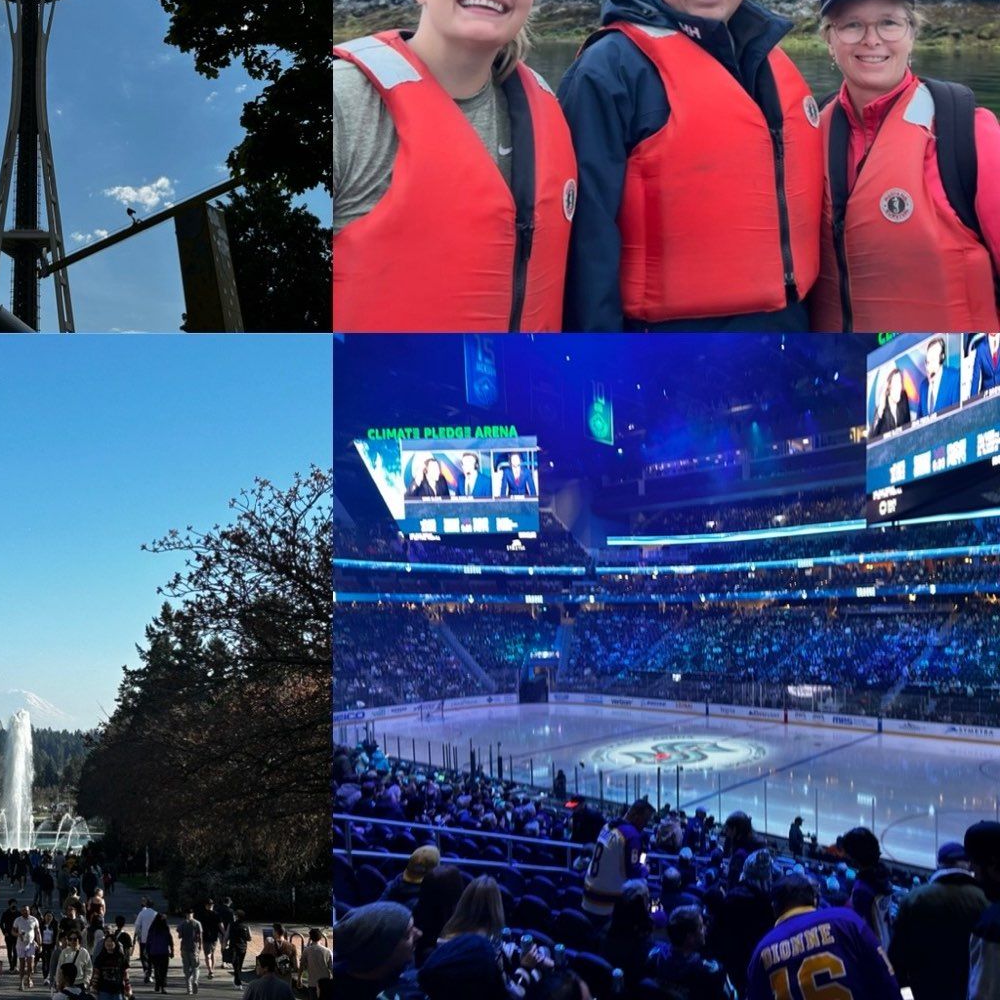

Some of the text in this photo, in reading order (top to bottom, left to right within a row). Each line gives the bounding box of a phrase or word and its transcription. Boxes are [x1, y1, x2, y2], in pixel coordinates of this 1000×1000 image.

[367, 425, 518, 440] CLIMATE PLEDGE ARENA
[761, 923, 834, 969] DIONNE
[769, 952, 853, 1000] 16
